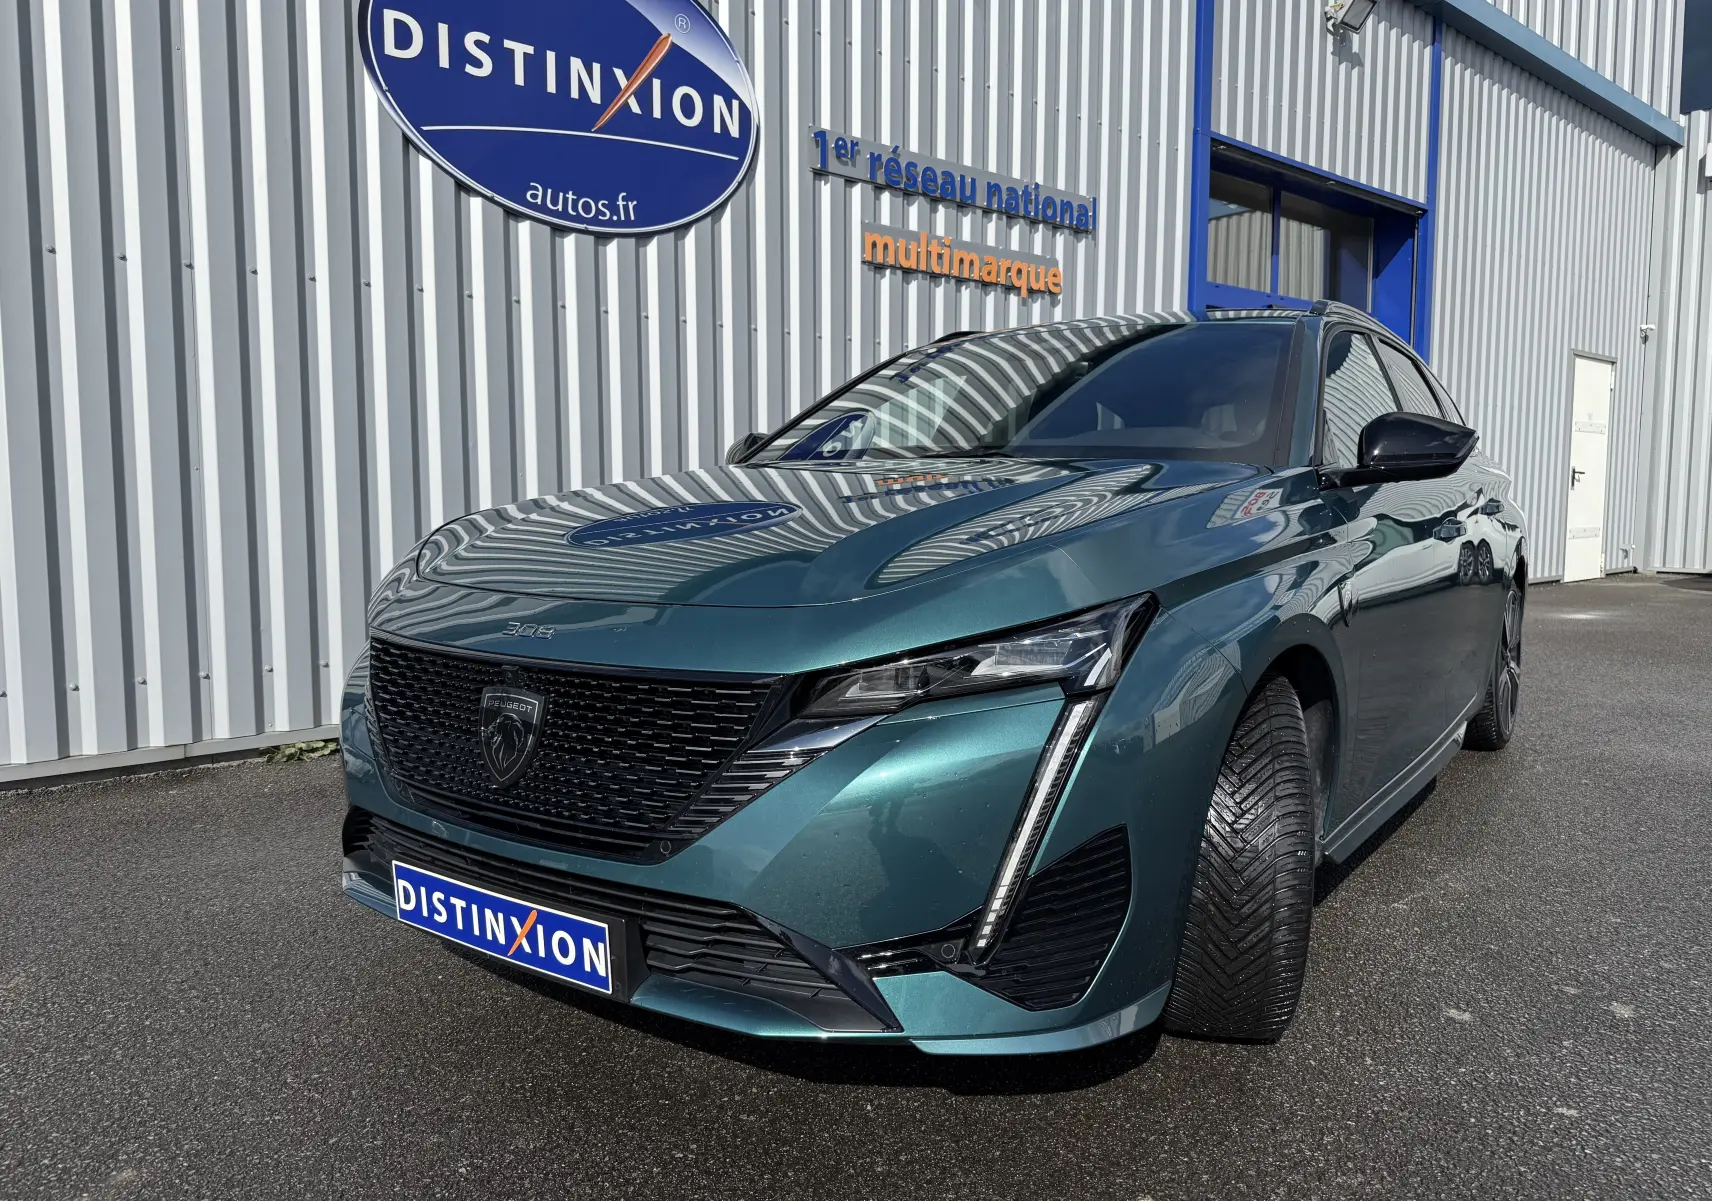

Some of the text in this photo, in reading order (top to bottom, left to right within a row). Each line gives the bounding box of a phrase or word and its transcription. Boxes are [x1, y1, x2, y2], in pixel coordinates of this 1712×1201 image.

[382, 8, 741, 139] DISTINXION
[525, 182, 638, 222] autos.fr
[813, 129, 1097, 231] 1er réseau national
[864, 231, 1063, 300] multimarque
[501, 621, 557, 640] 308
[487, 700, 533, 713] PEUGEOT
[397, 878, 607, 977] DISTINXION
